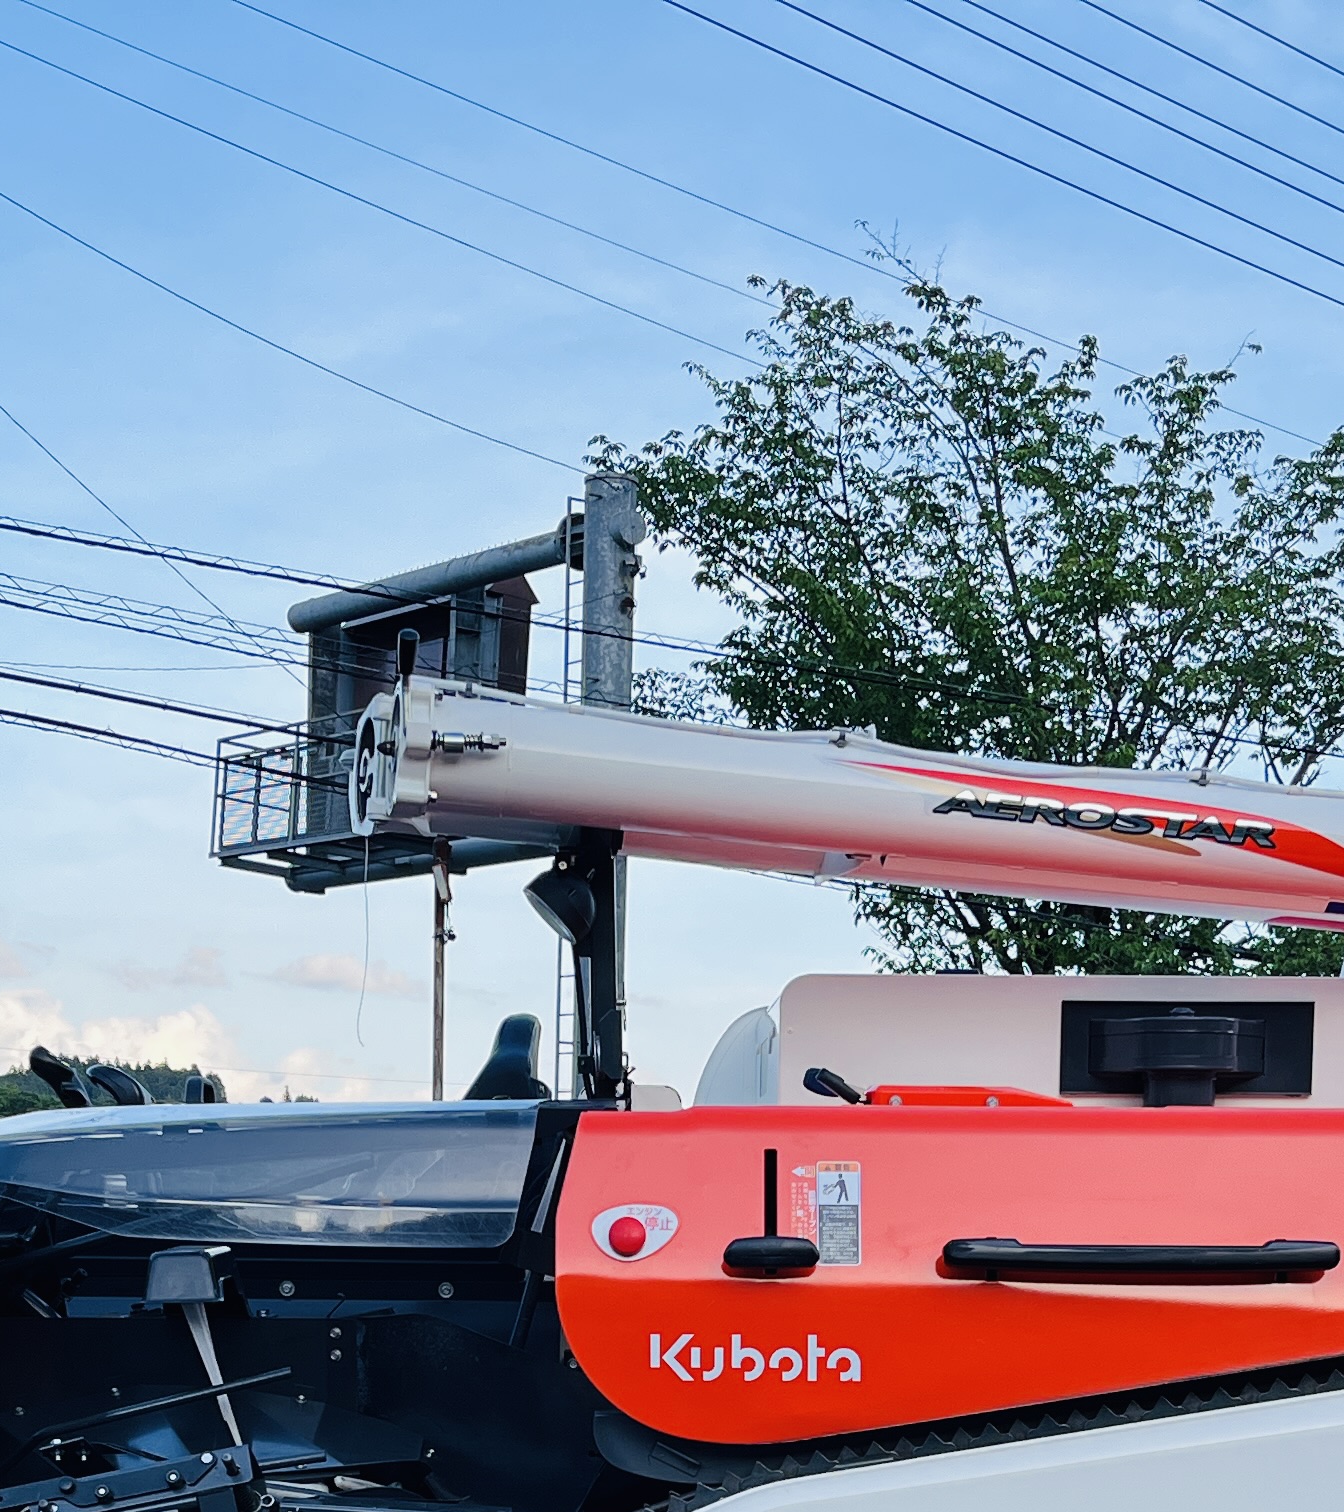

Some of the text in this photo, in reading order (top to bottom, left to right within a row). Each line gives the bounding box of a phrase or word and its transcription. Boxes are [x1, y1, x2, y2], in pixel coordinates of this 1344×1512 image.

[933, 789, 1277, 849] AEROSTAR
[626, 1207, 663, 1216] エンジン
[645, 1217, 674, 1231] 停止
[649, 1333, 862, 1382] Kubota
